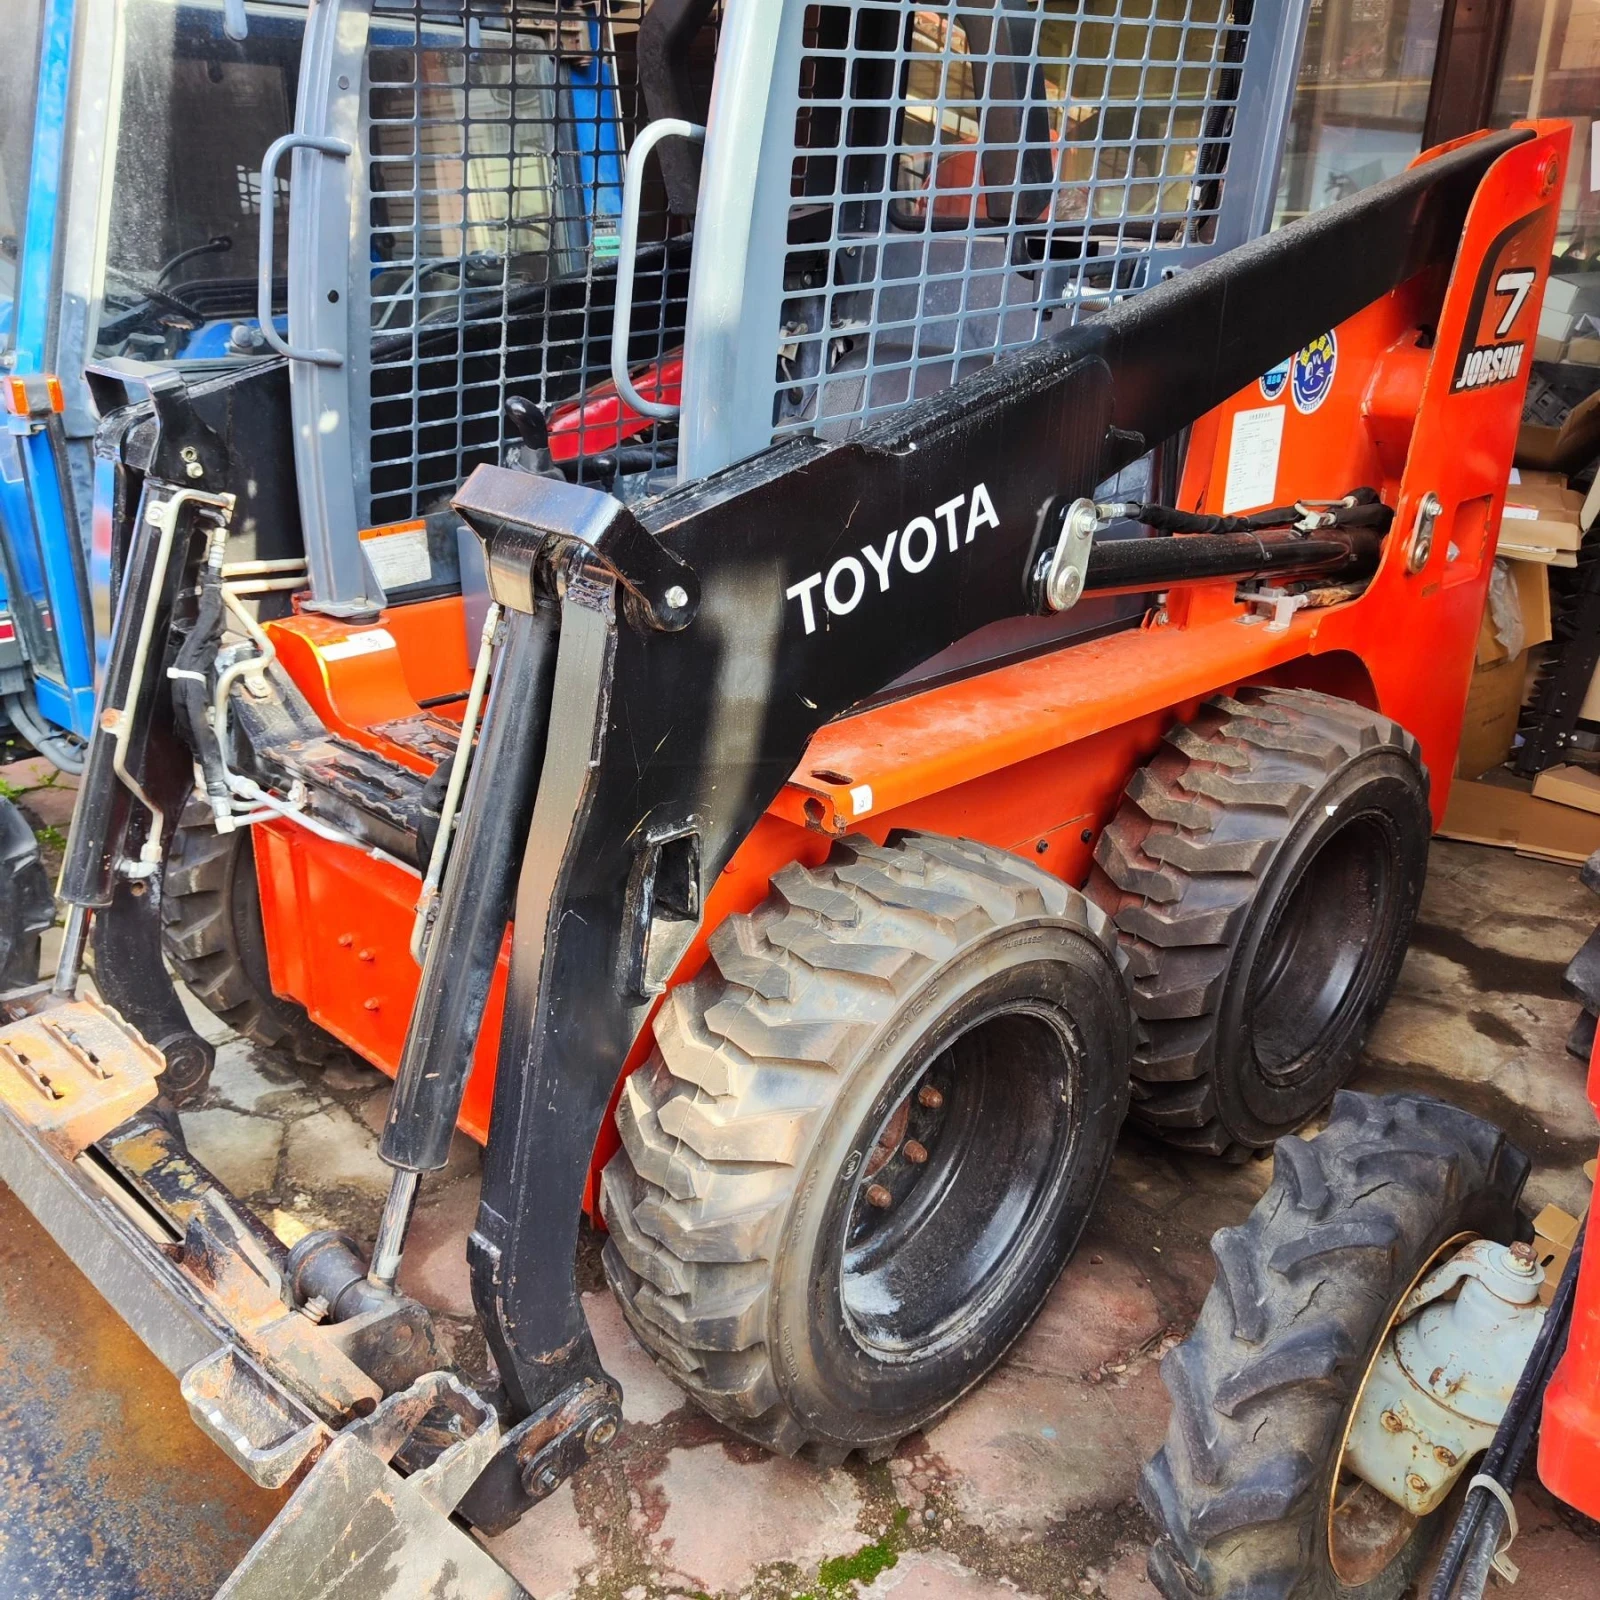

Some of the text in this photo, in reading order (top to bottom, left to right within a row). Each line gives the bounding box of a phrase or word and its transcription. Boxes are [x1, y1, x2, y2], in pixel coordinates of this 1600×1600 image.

[1496, 271, 1535, 335] 7
[1455, 343, 1525, 389] JOBSUN
[786, 482, 1000, 635] TOYOTA
